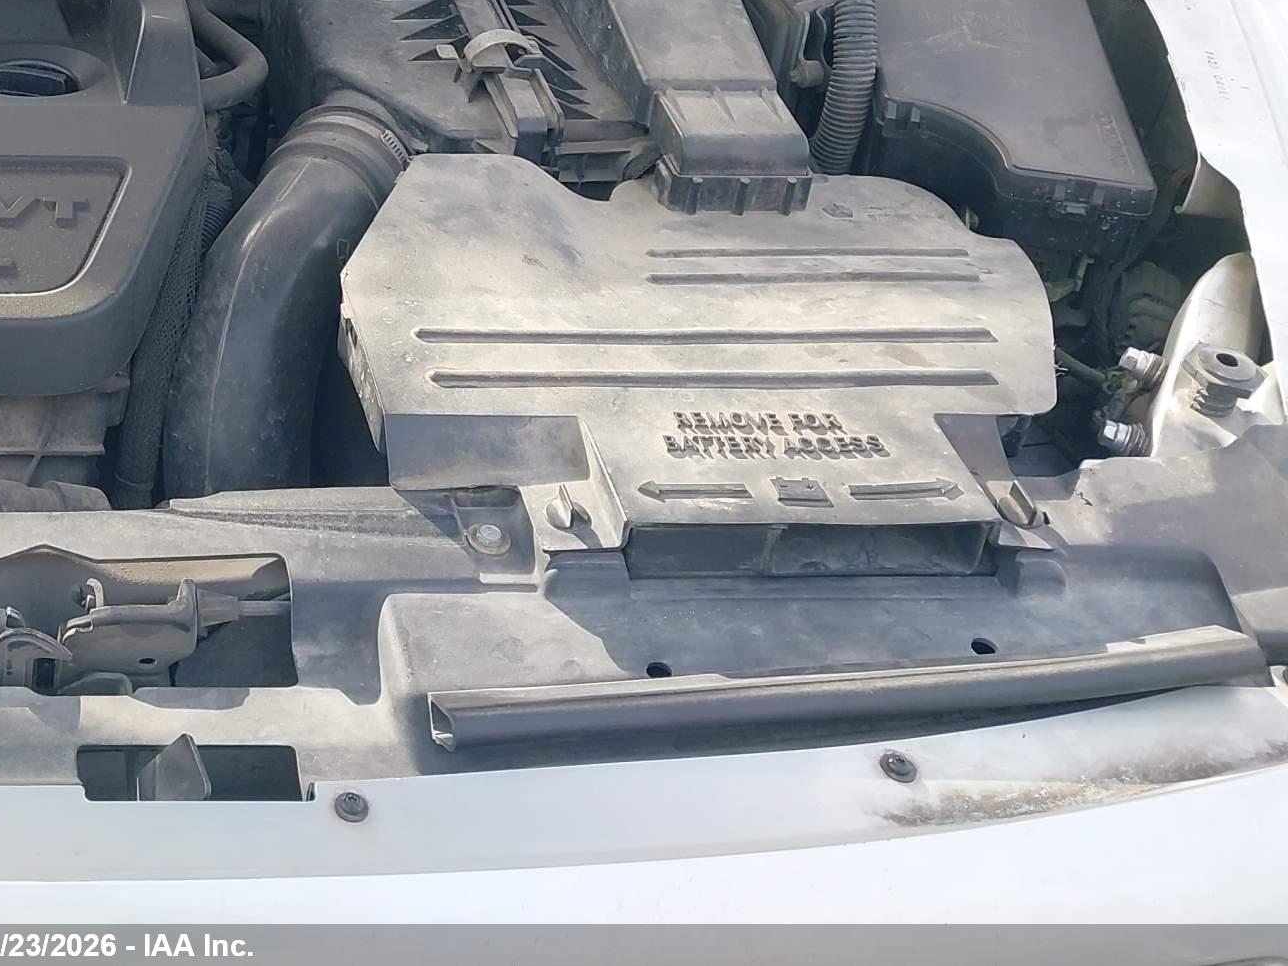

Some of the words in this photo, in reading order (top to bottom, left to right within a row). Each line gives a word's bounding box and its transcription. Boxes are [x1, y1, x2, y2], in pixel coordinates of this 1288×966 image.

[673, 410, 784, 435] REMOVE
[791, 411, 848, 435] FOR
[665, 434, 777, 459] BATTERY
[784, 435, 894, 459] ACCESS
